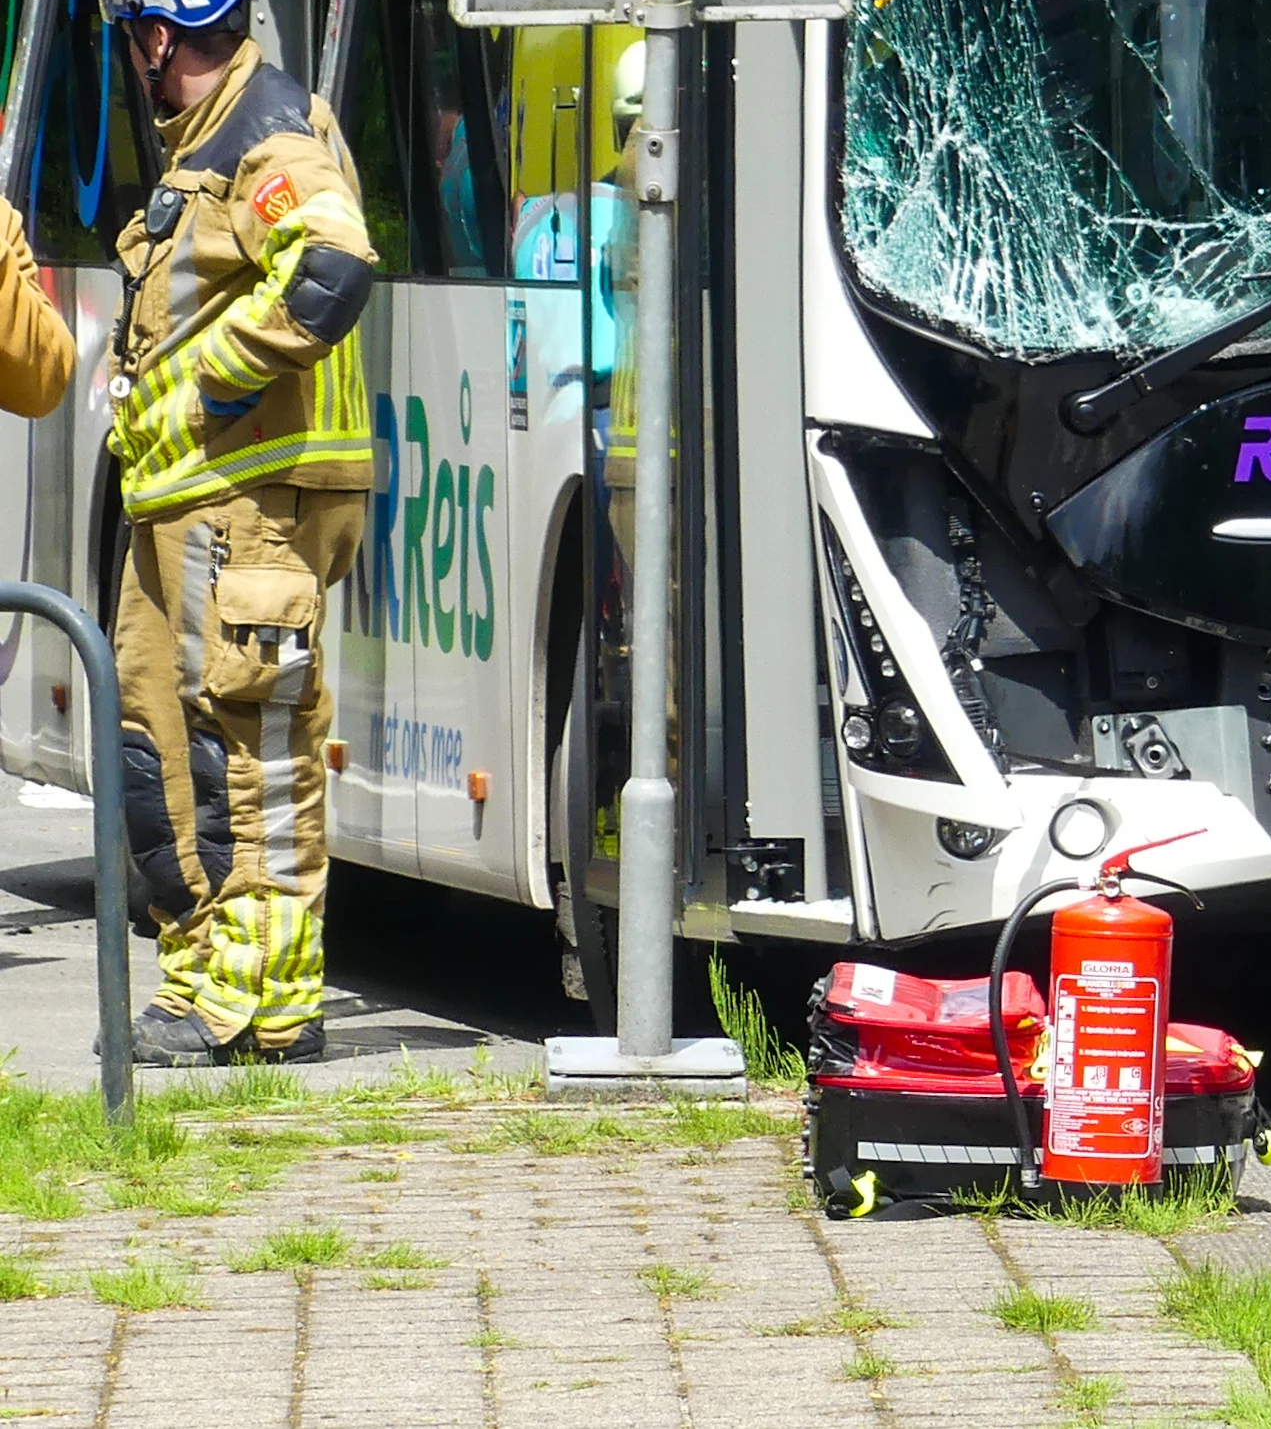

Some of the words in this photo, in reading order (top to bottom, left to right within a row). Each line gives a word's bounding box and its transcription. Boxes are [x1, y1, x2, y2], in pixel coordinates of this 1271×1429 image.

[369, 702, 398, 776] met
[402, 720, 428, 784] ons
[430, 724, 463, 790] mee
[1083, 963, 1131, 974] GLORIA
